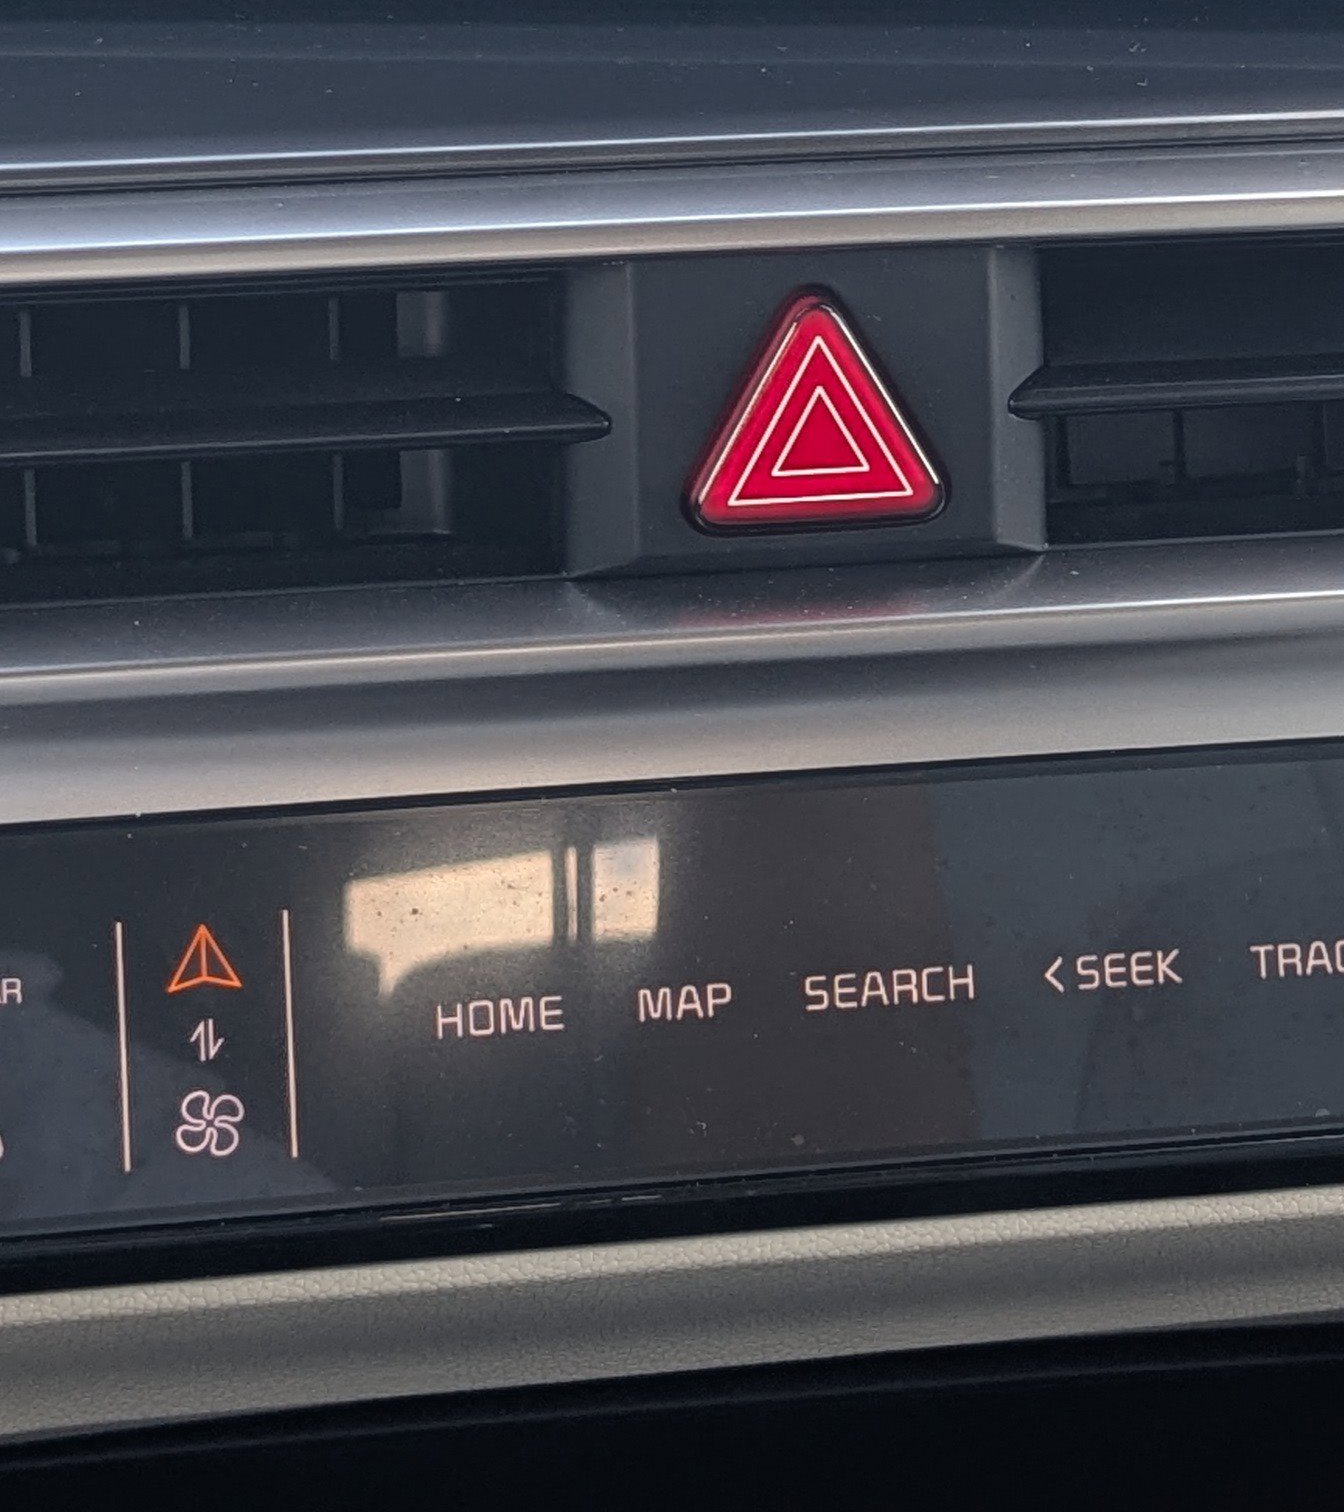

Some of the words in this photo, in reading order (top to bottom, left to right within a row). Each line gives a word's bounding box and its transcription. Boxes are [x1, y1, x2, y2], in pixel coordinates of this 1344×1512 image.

[637, 983, 732, 1024] MAP
[805, 965, 976, 1012] SEARCH
[436, 995, 565, 1040] HOME
